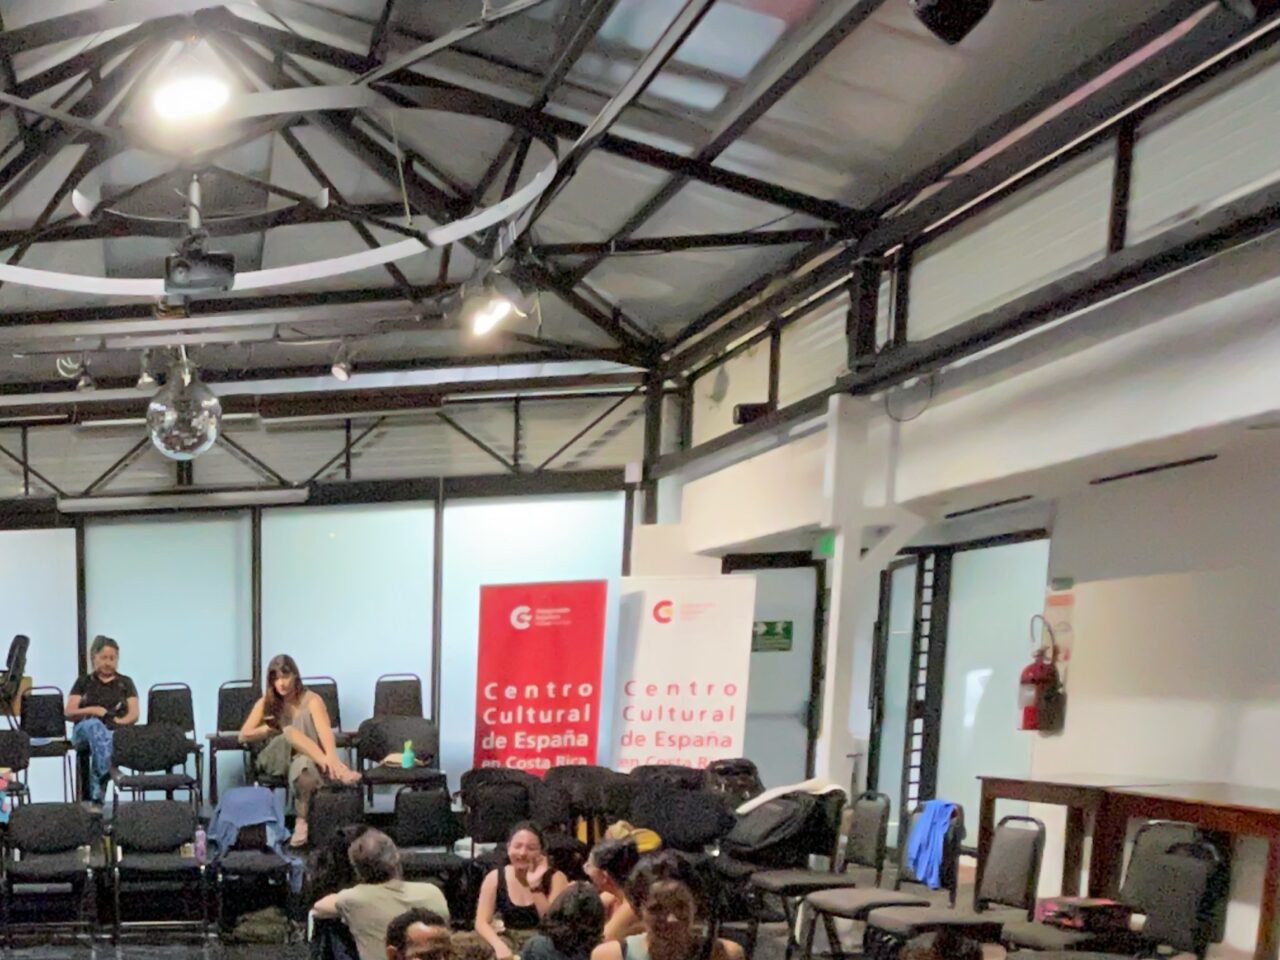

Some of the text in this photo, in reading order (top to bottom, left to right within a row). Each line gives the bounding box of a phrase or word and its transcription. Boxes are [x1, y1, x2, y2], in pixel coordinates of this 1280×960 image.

[484, 681, 593, 700] Centro
[623, 680, 737, 697] Centro
[482, 703, 591, 725] Cultural
[622, 703, 735, 722] Cultural
[481, 729, 589, 752] de España
[620, 729, 733, 751] de España
[482, 754, 588, 770] en Costa Rica
